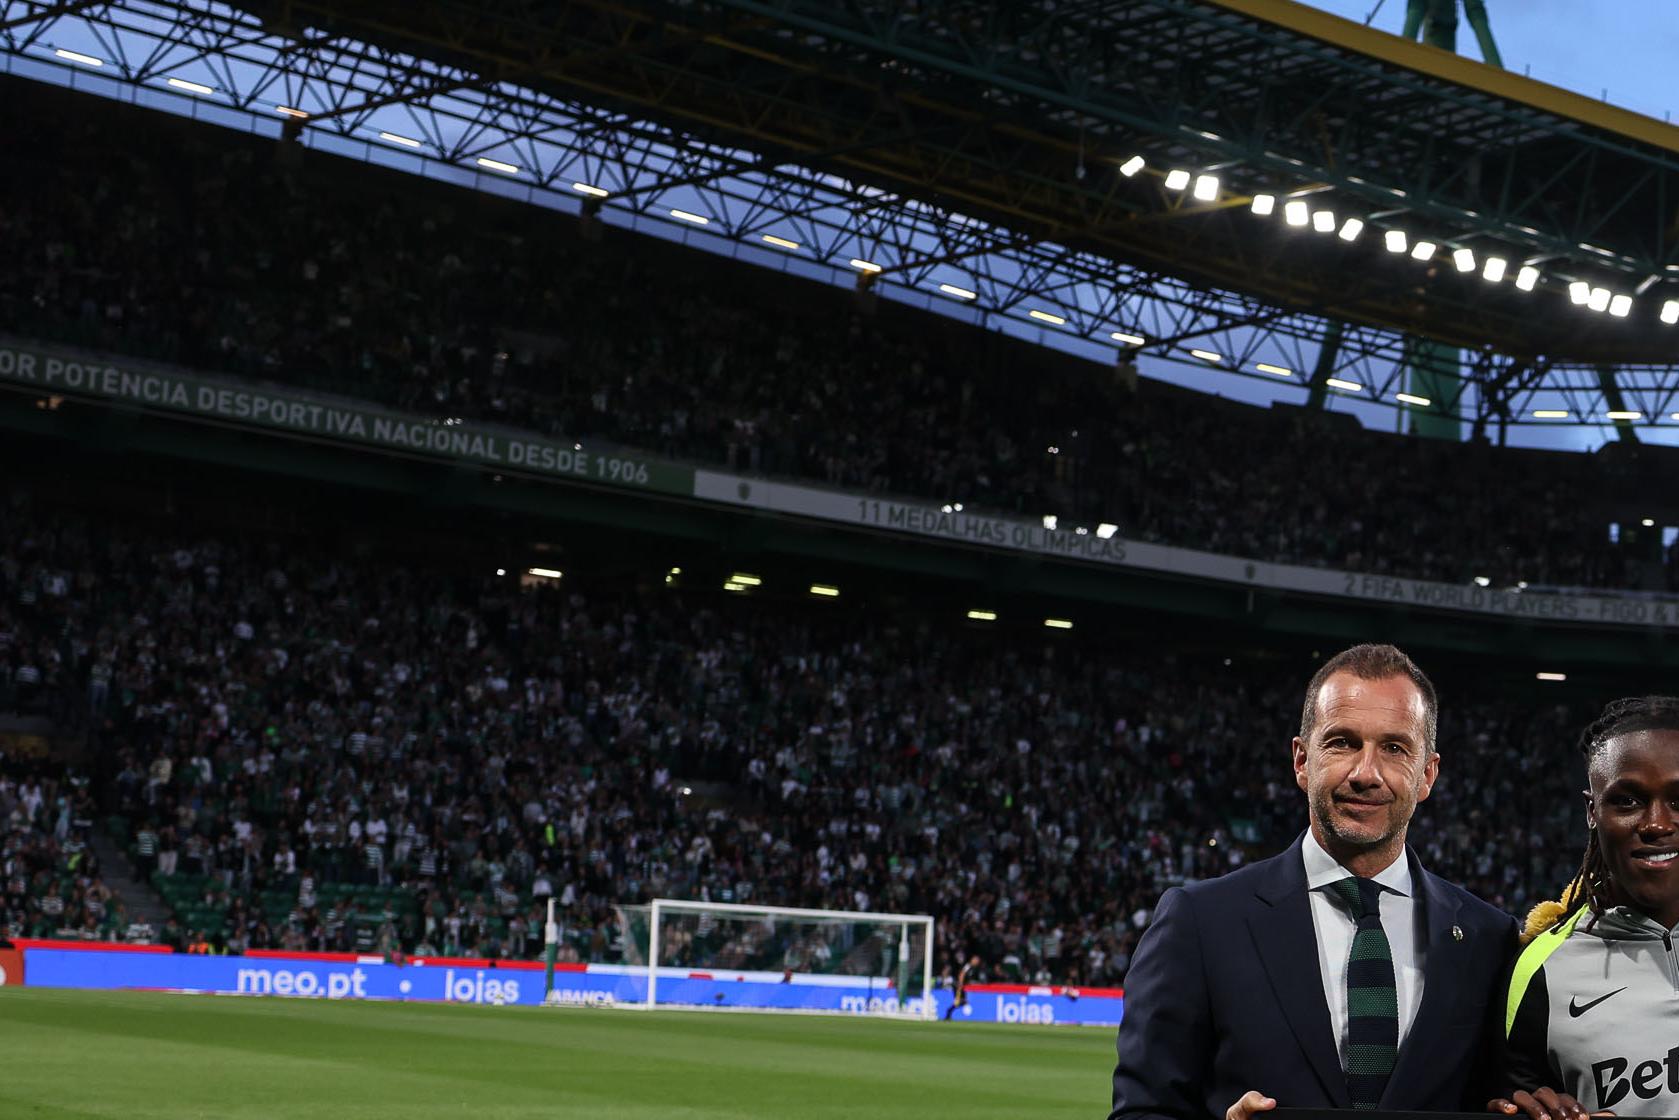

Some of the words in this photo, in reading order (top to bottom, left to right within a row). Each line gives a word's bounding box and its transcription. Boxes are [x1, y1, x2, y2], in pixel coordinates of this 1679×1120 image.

[45, 359, 189, 407] POTÊNCIA
[197, 387, 366, 436] DESPORTIVA
[374, 418, 501, 461] NACIONAL
[508, 441, 588, 475] DESDE
[595, 457, 649, 484] 1906
[857, 500, 880, 521] 11
[889, 504, 1005, 543] MEDALHAS
[1361, 577, 1404, 600] FIFA
[1412, 583, 1485, 609] WORLD
[1490, 592, 1579, 617] PLAYERS
[1601, 600, 1648, 622] FIGO
[237, 968, 367, 998] meo.pt
[445, 969, 519, 1003] lojas
